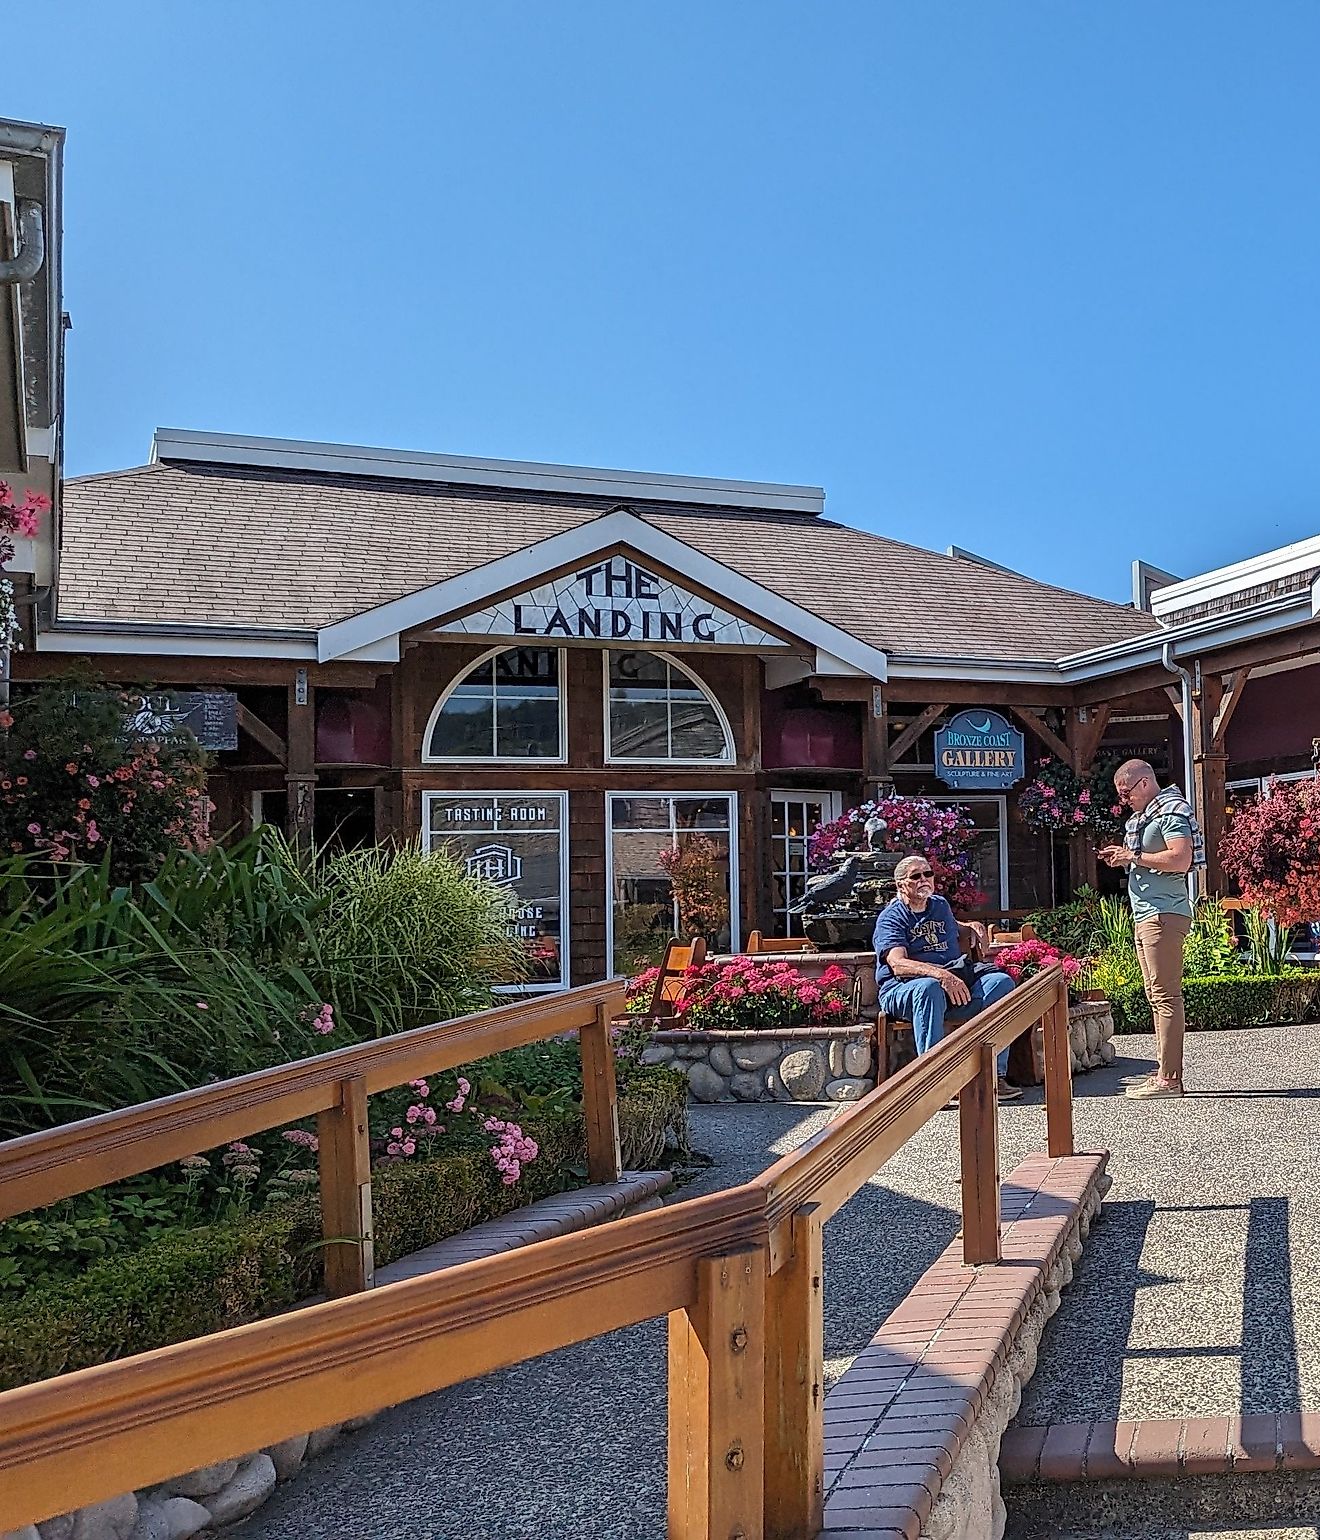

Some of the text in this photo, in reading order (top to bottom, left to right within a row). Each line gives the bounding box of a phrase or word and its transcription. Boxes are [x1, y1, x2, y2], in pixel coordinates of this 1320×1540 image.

[576, 558, 659, 600] THE
[514, 604, 716, 642] LANDING
[947, 731, 1011, 747] BRONZE COAST
[942, 750, 1016, 768] GALLERY
[445, 808, 546, 821] TASTING ROOM
